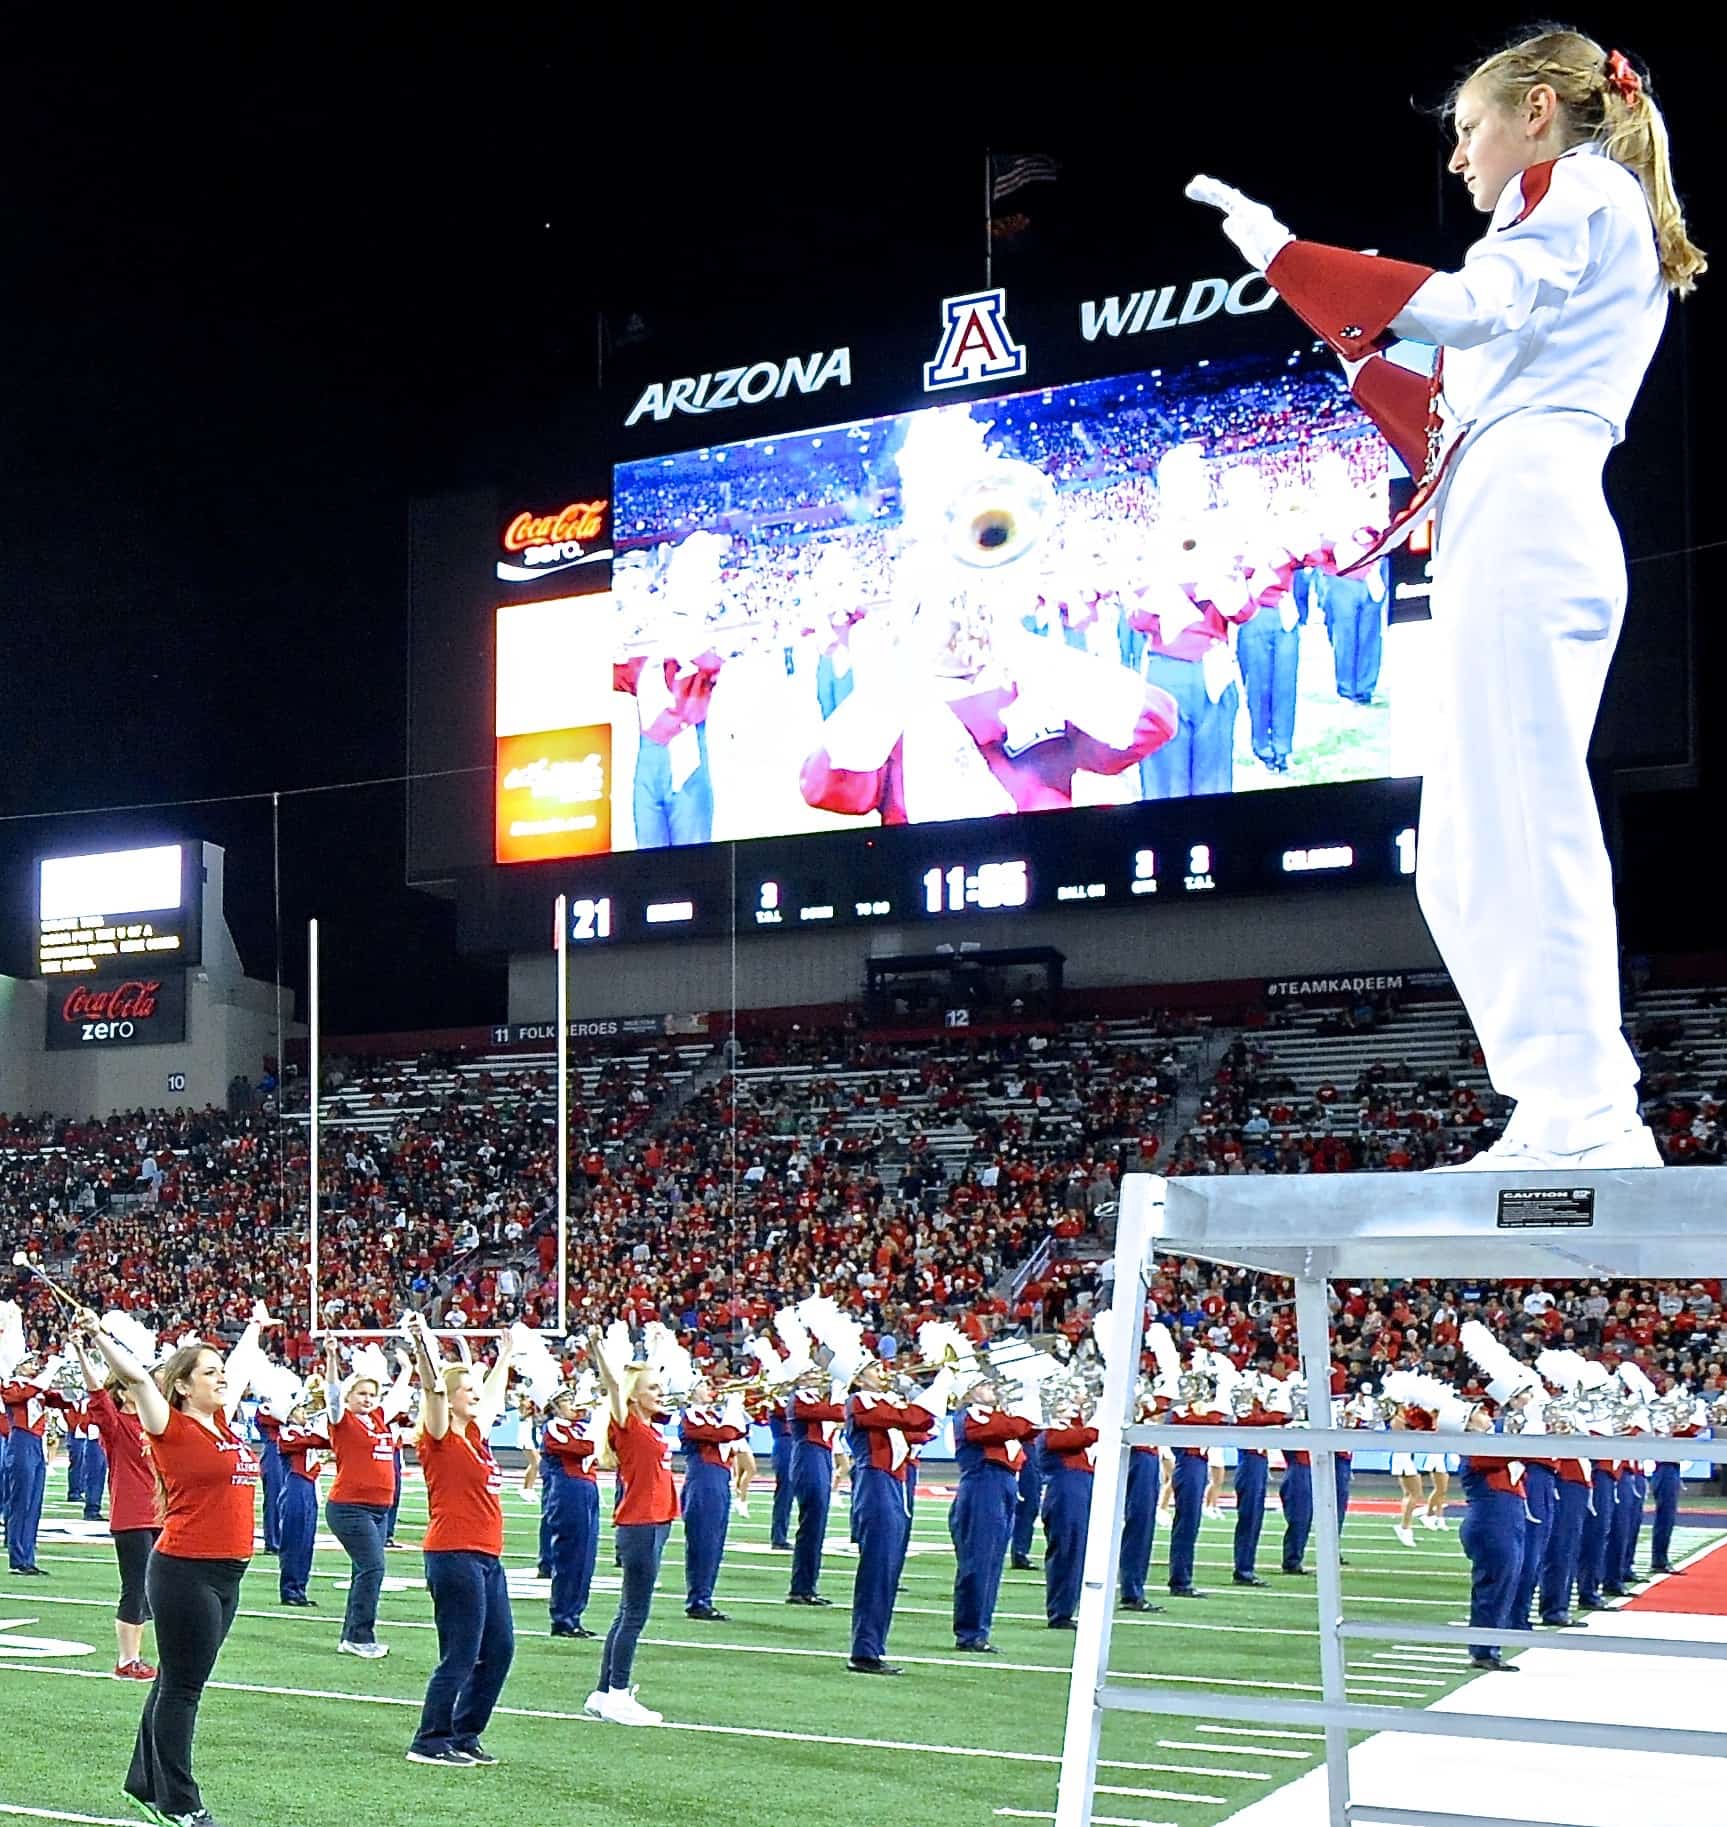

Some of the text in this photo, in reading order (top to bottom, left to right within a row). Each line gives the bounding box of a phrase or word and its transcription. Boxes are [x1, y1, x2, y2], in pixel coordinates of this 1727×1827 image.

[1081, 271, 1280, 341] WILDC
[923, 287, 1026, 392] A
[624, 346, 851, 426] ARIZONA
[573, 898, 610, 939] 21
[1268, 976, 1403, 996] #TEAMKADEEM
[946, 1009, 969, 1027] 12
[82, 1021, 134, 1041] zero
[494, 1028, 509, 1043] 11
[519, 1026, 555, 1040] FOLK
[568, 1022, 617, 1037] EROES
[168, 1075, 185, 1090] 10
